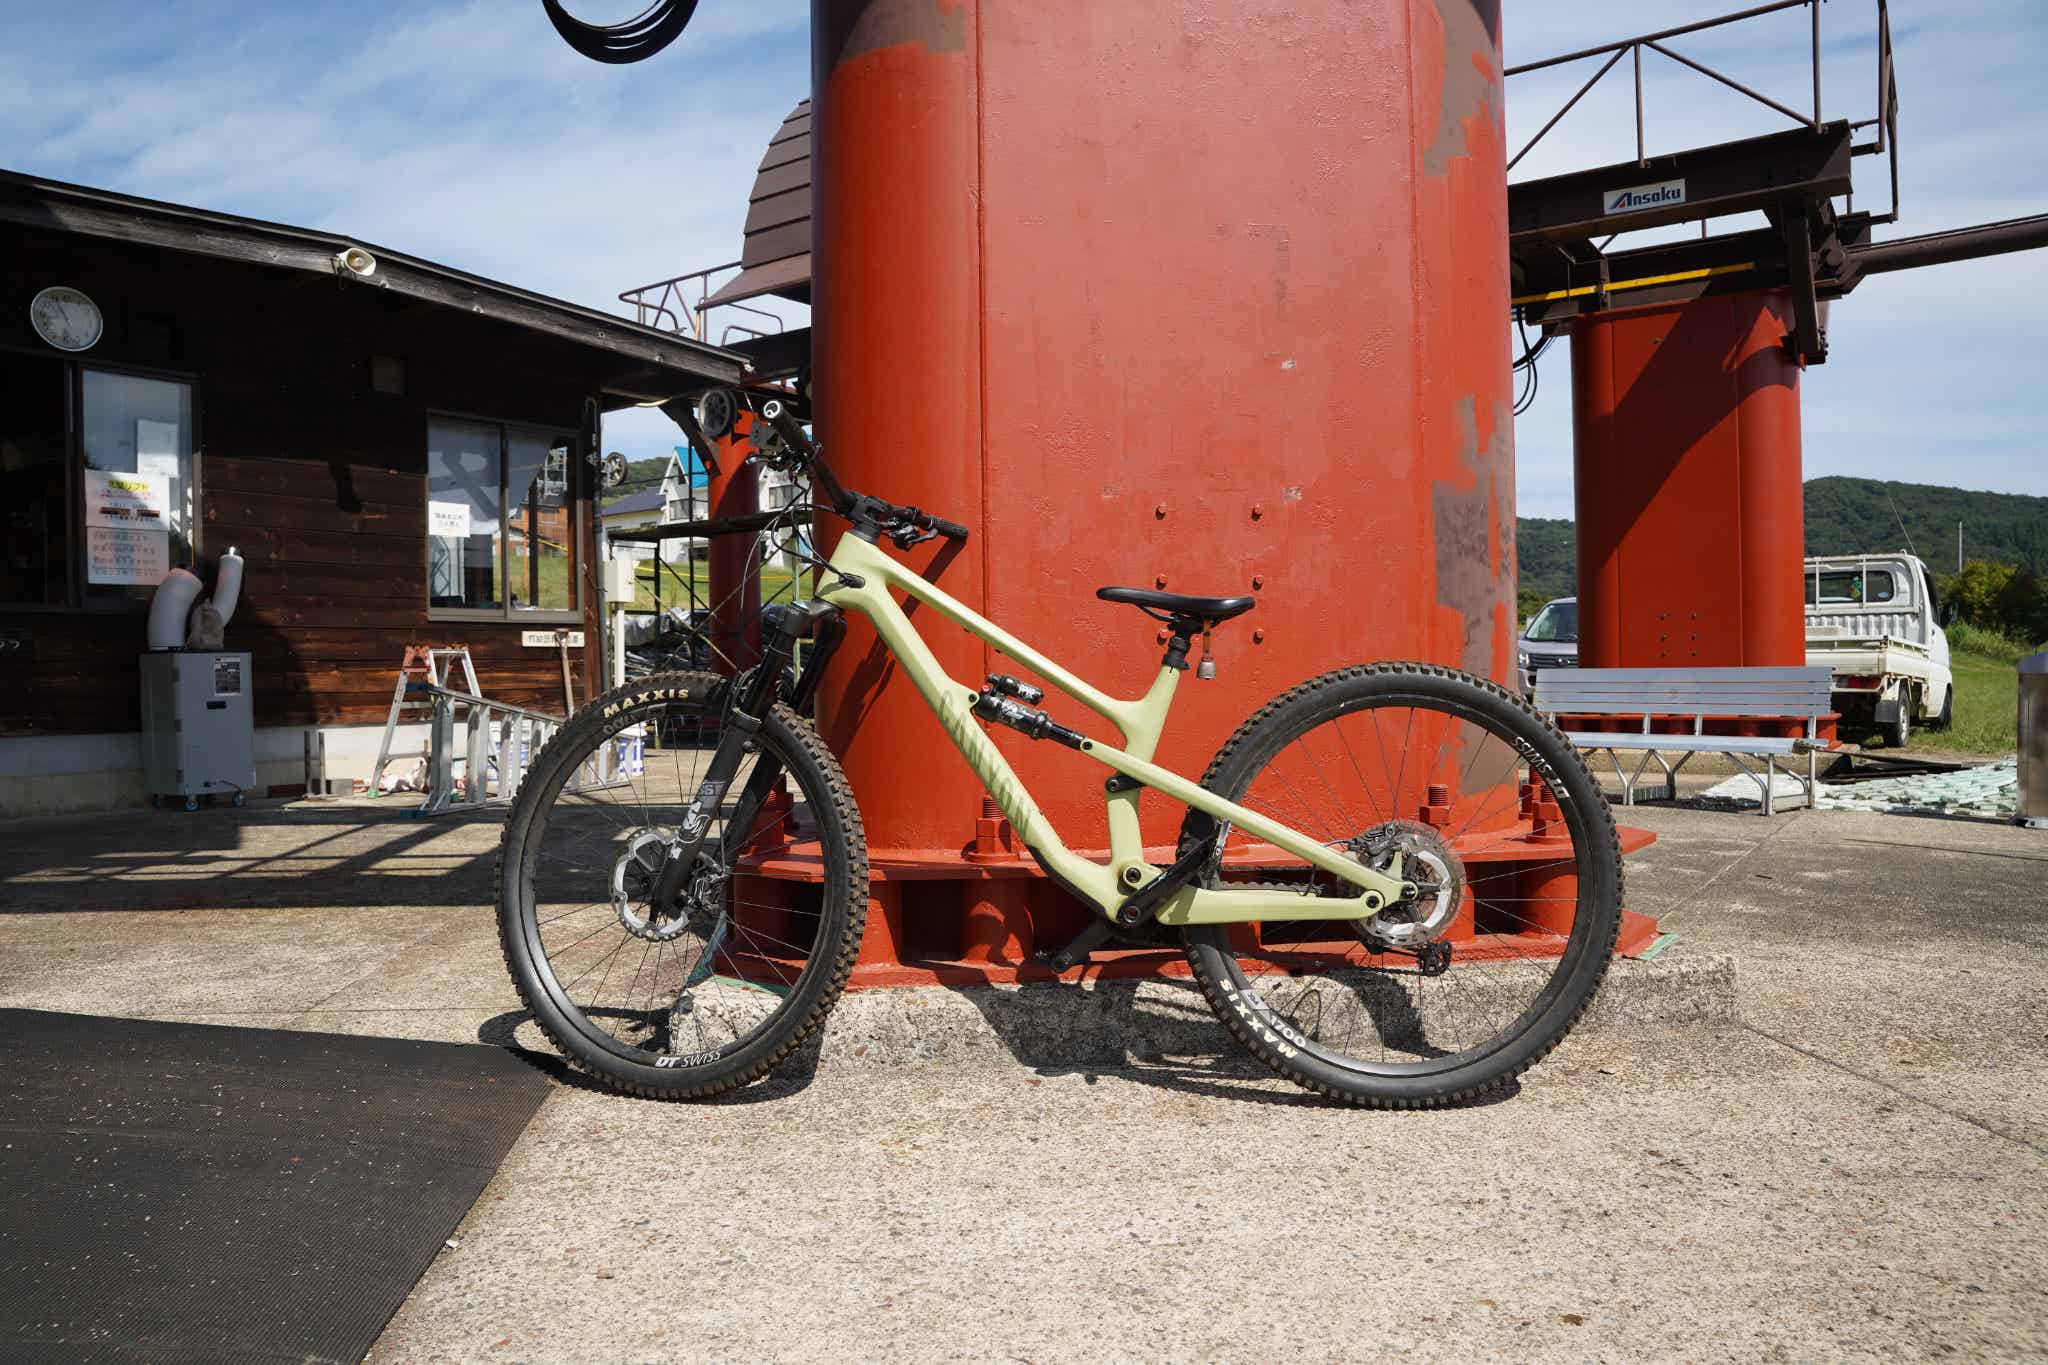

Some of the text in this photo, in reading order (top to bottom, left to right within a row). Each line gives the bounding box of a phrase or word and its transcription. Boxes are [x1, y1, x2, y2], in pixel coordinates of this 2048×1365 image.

[603, 688, 689, 718] MAXXIS
[938, 689, 1032, 836] CANYON
[1512, 736, 1570, 798] DT SWISS
[1219, 979, 1299, 1058] MAXXIS
[1271, 1015, 1306, 1048] 1700
[655, 1049, 721, 1068] DT SWISS
